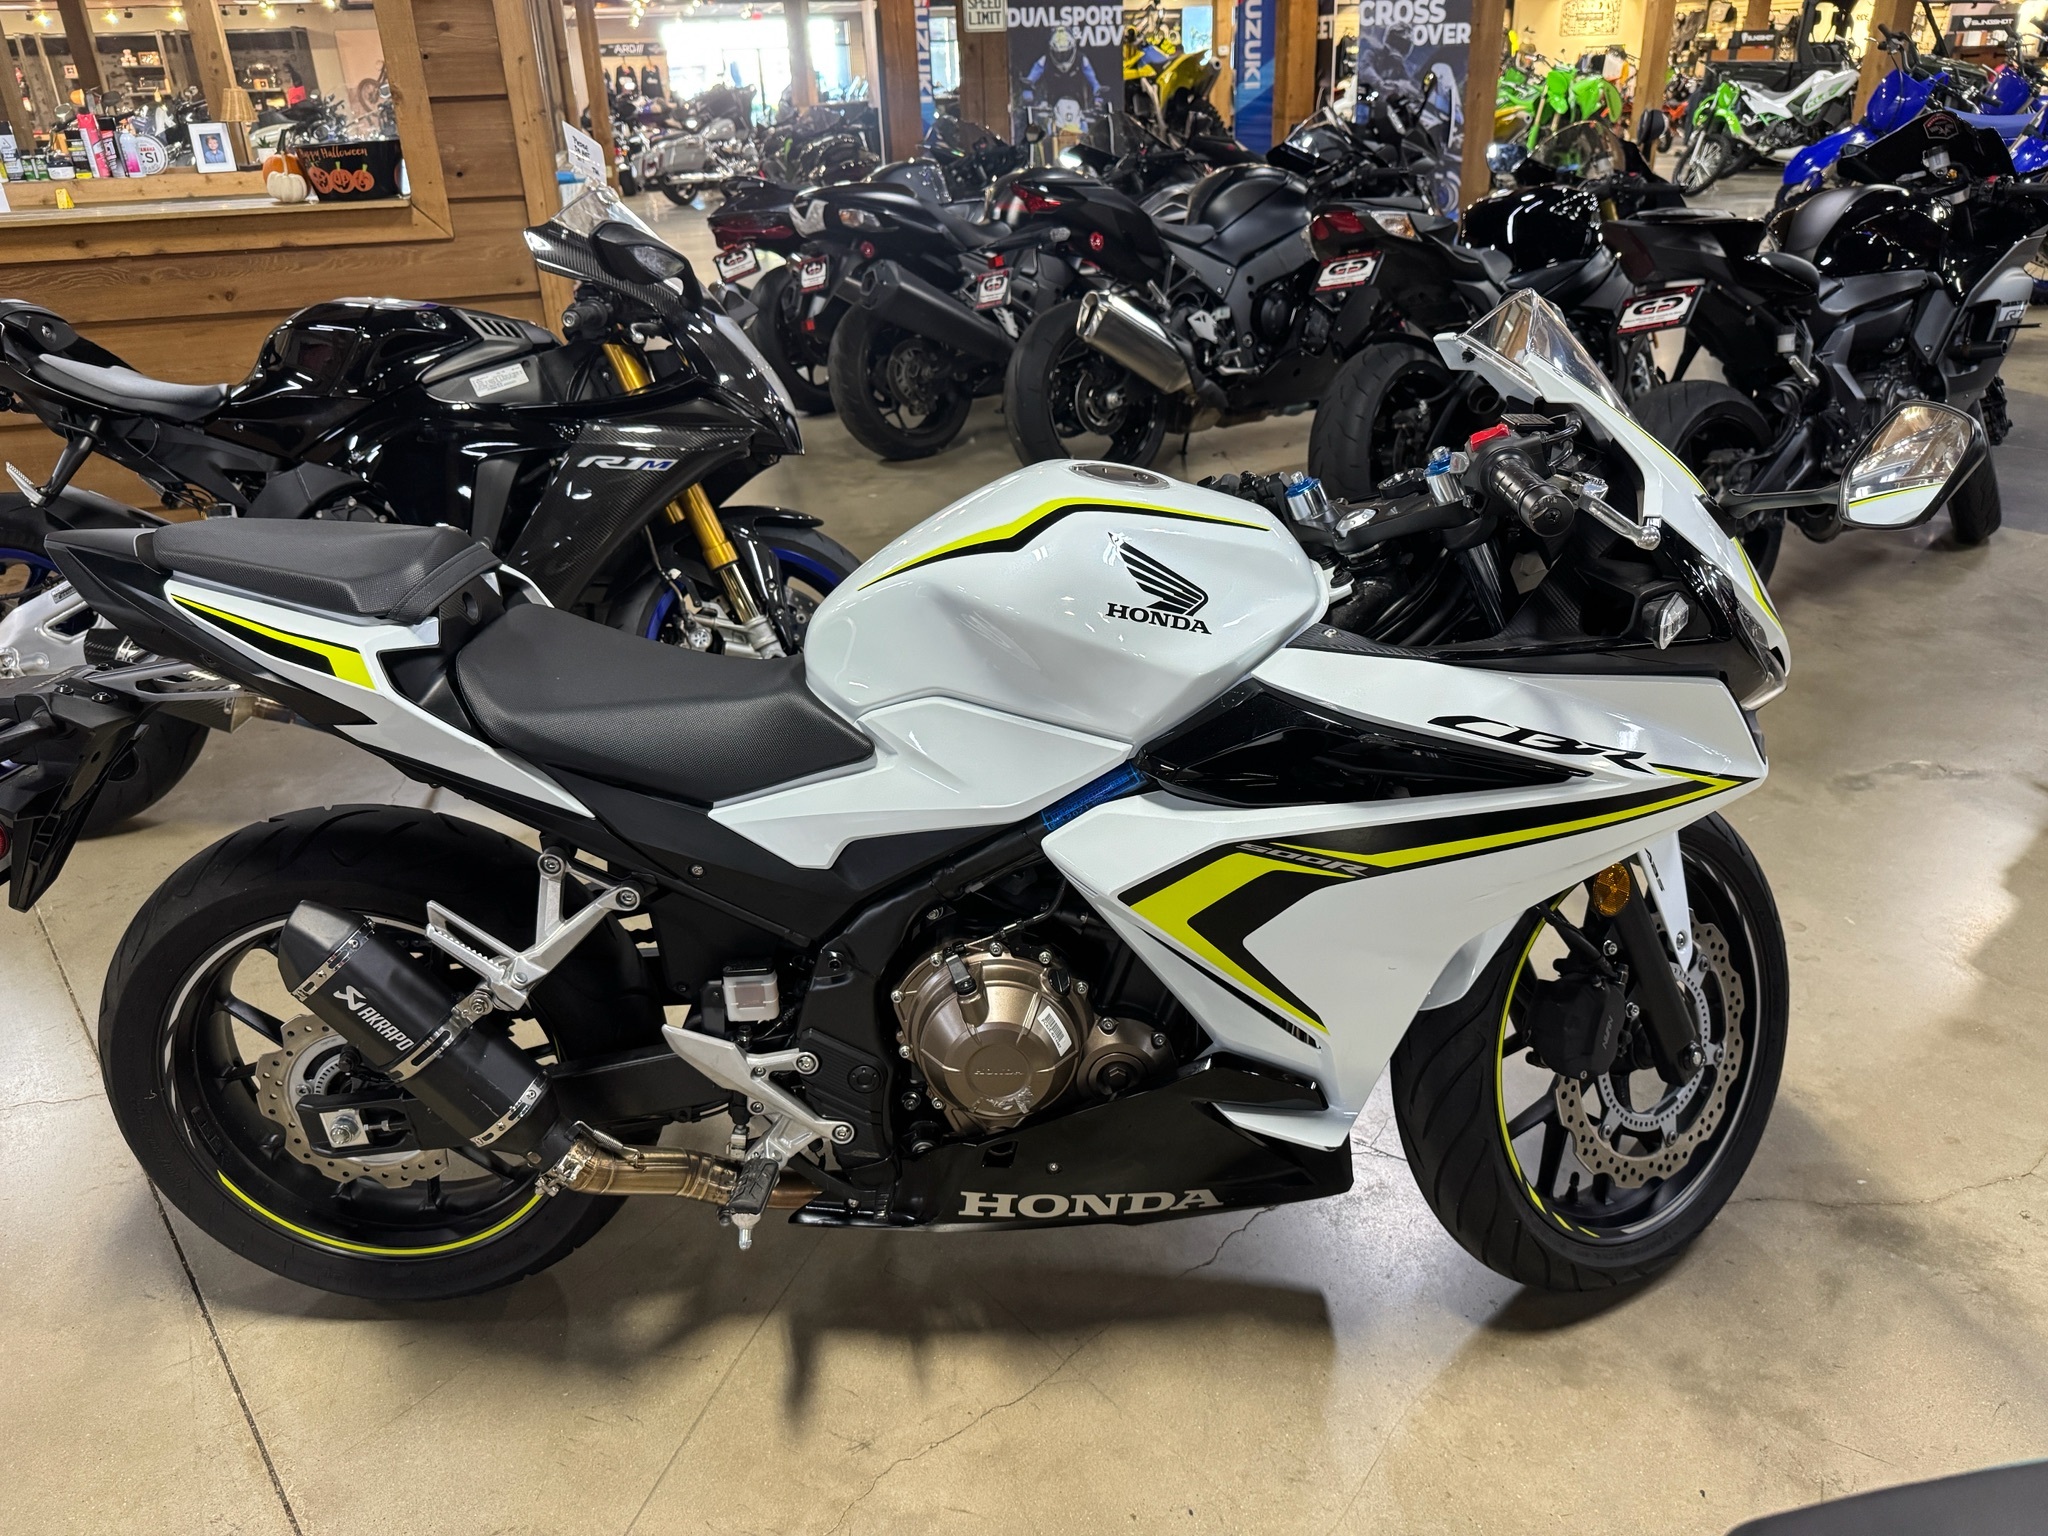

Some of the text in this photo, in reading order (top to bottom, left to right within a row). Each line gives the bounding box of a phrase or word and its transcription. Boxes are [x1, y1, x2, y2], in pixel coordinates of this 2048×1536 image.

[968, 10, 1002, 25] LIMIT
[1007, 5, 1124, 29] DUALSPORT
[1360, 0, 1447, 27] CROSS
[1411, 22, 1472, 46] OVER
[320, 146, 368, 159] Halloween
[1105, 602, 1212, 635] HONDA
[1427, 715, 1657, 776] CBR
[1235, 842, 1369, 878] 500R
[958, 1188, 1225, 1219] HONDA
